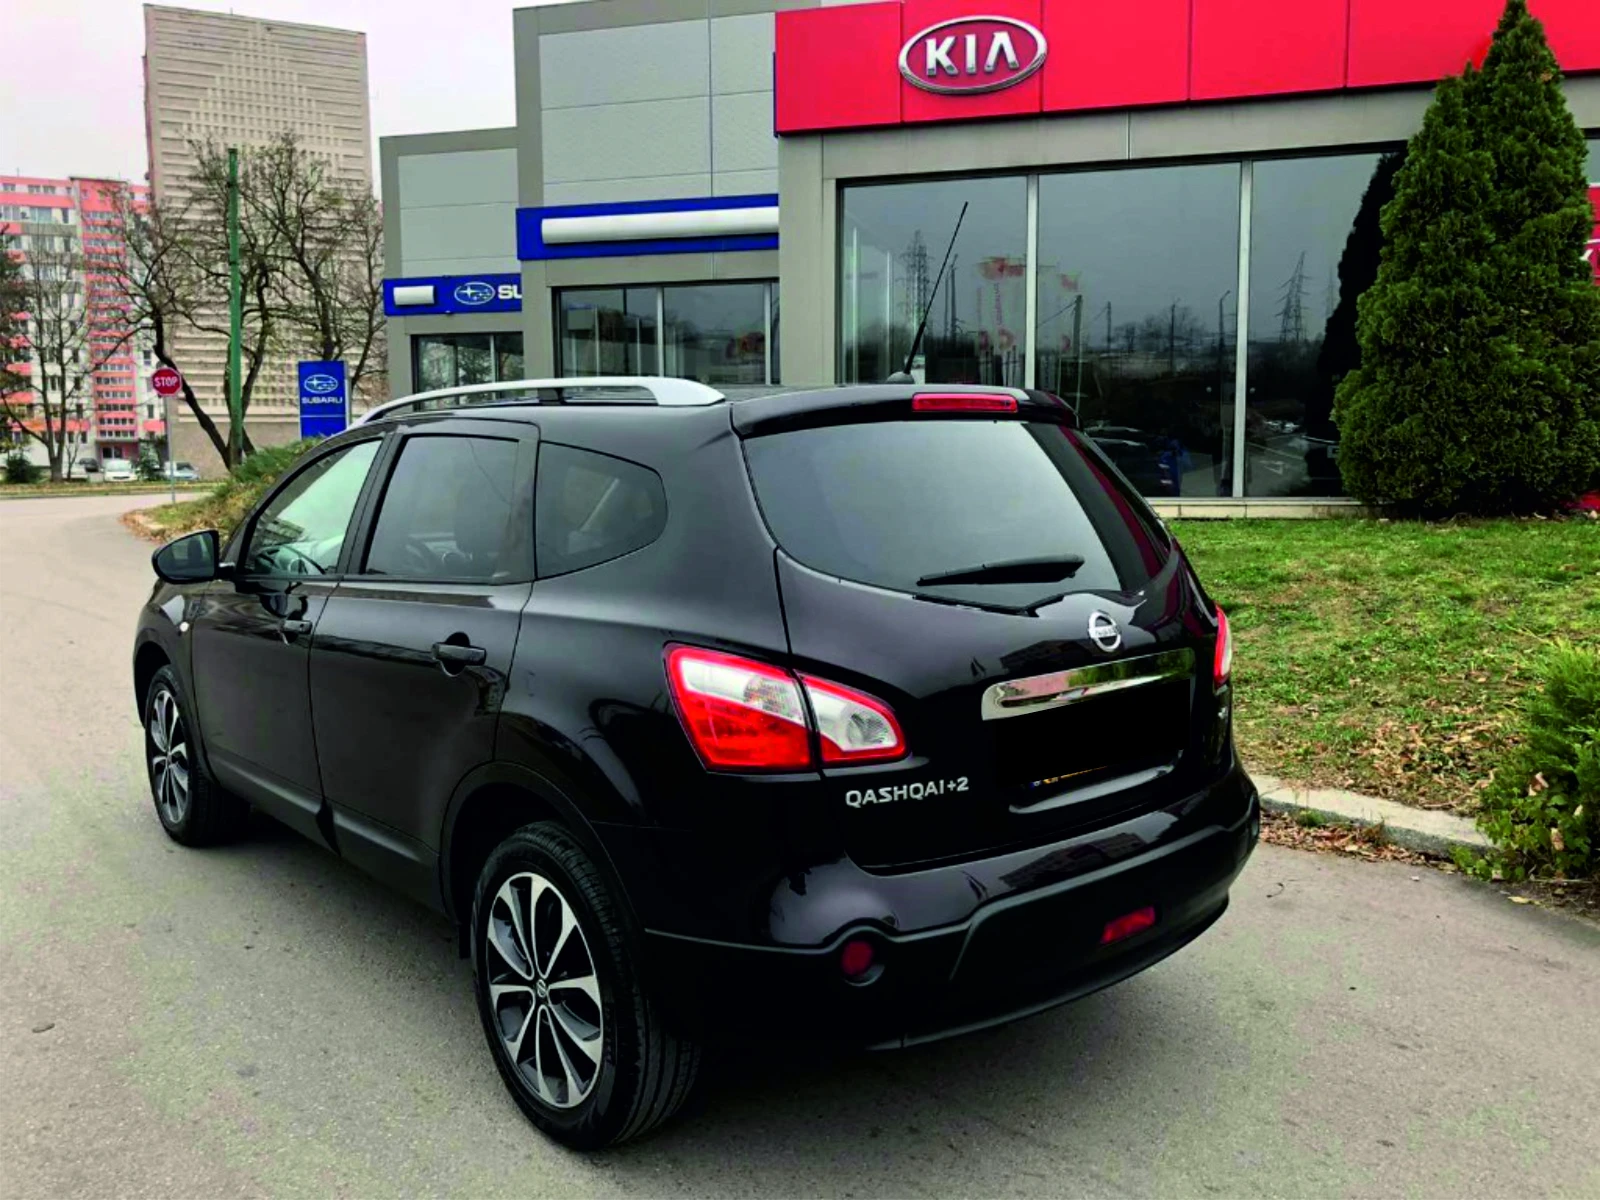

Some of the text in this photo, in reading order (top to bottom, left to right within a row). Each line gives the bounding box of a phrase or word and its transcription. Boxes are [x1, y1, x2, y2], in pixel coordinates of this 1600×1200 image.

[925, 31, 1020, 76] KIA
[154, 376, 178, 387] STOP
[301, 396, 343, 404] SUBARU
[845, 776, 970, 809] QASHQAI+2
